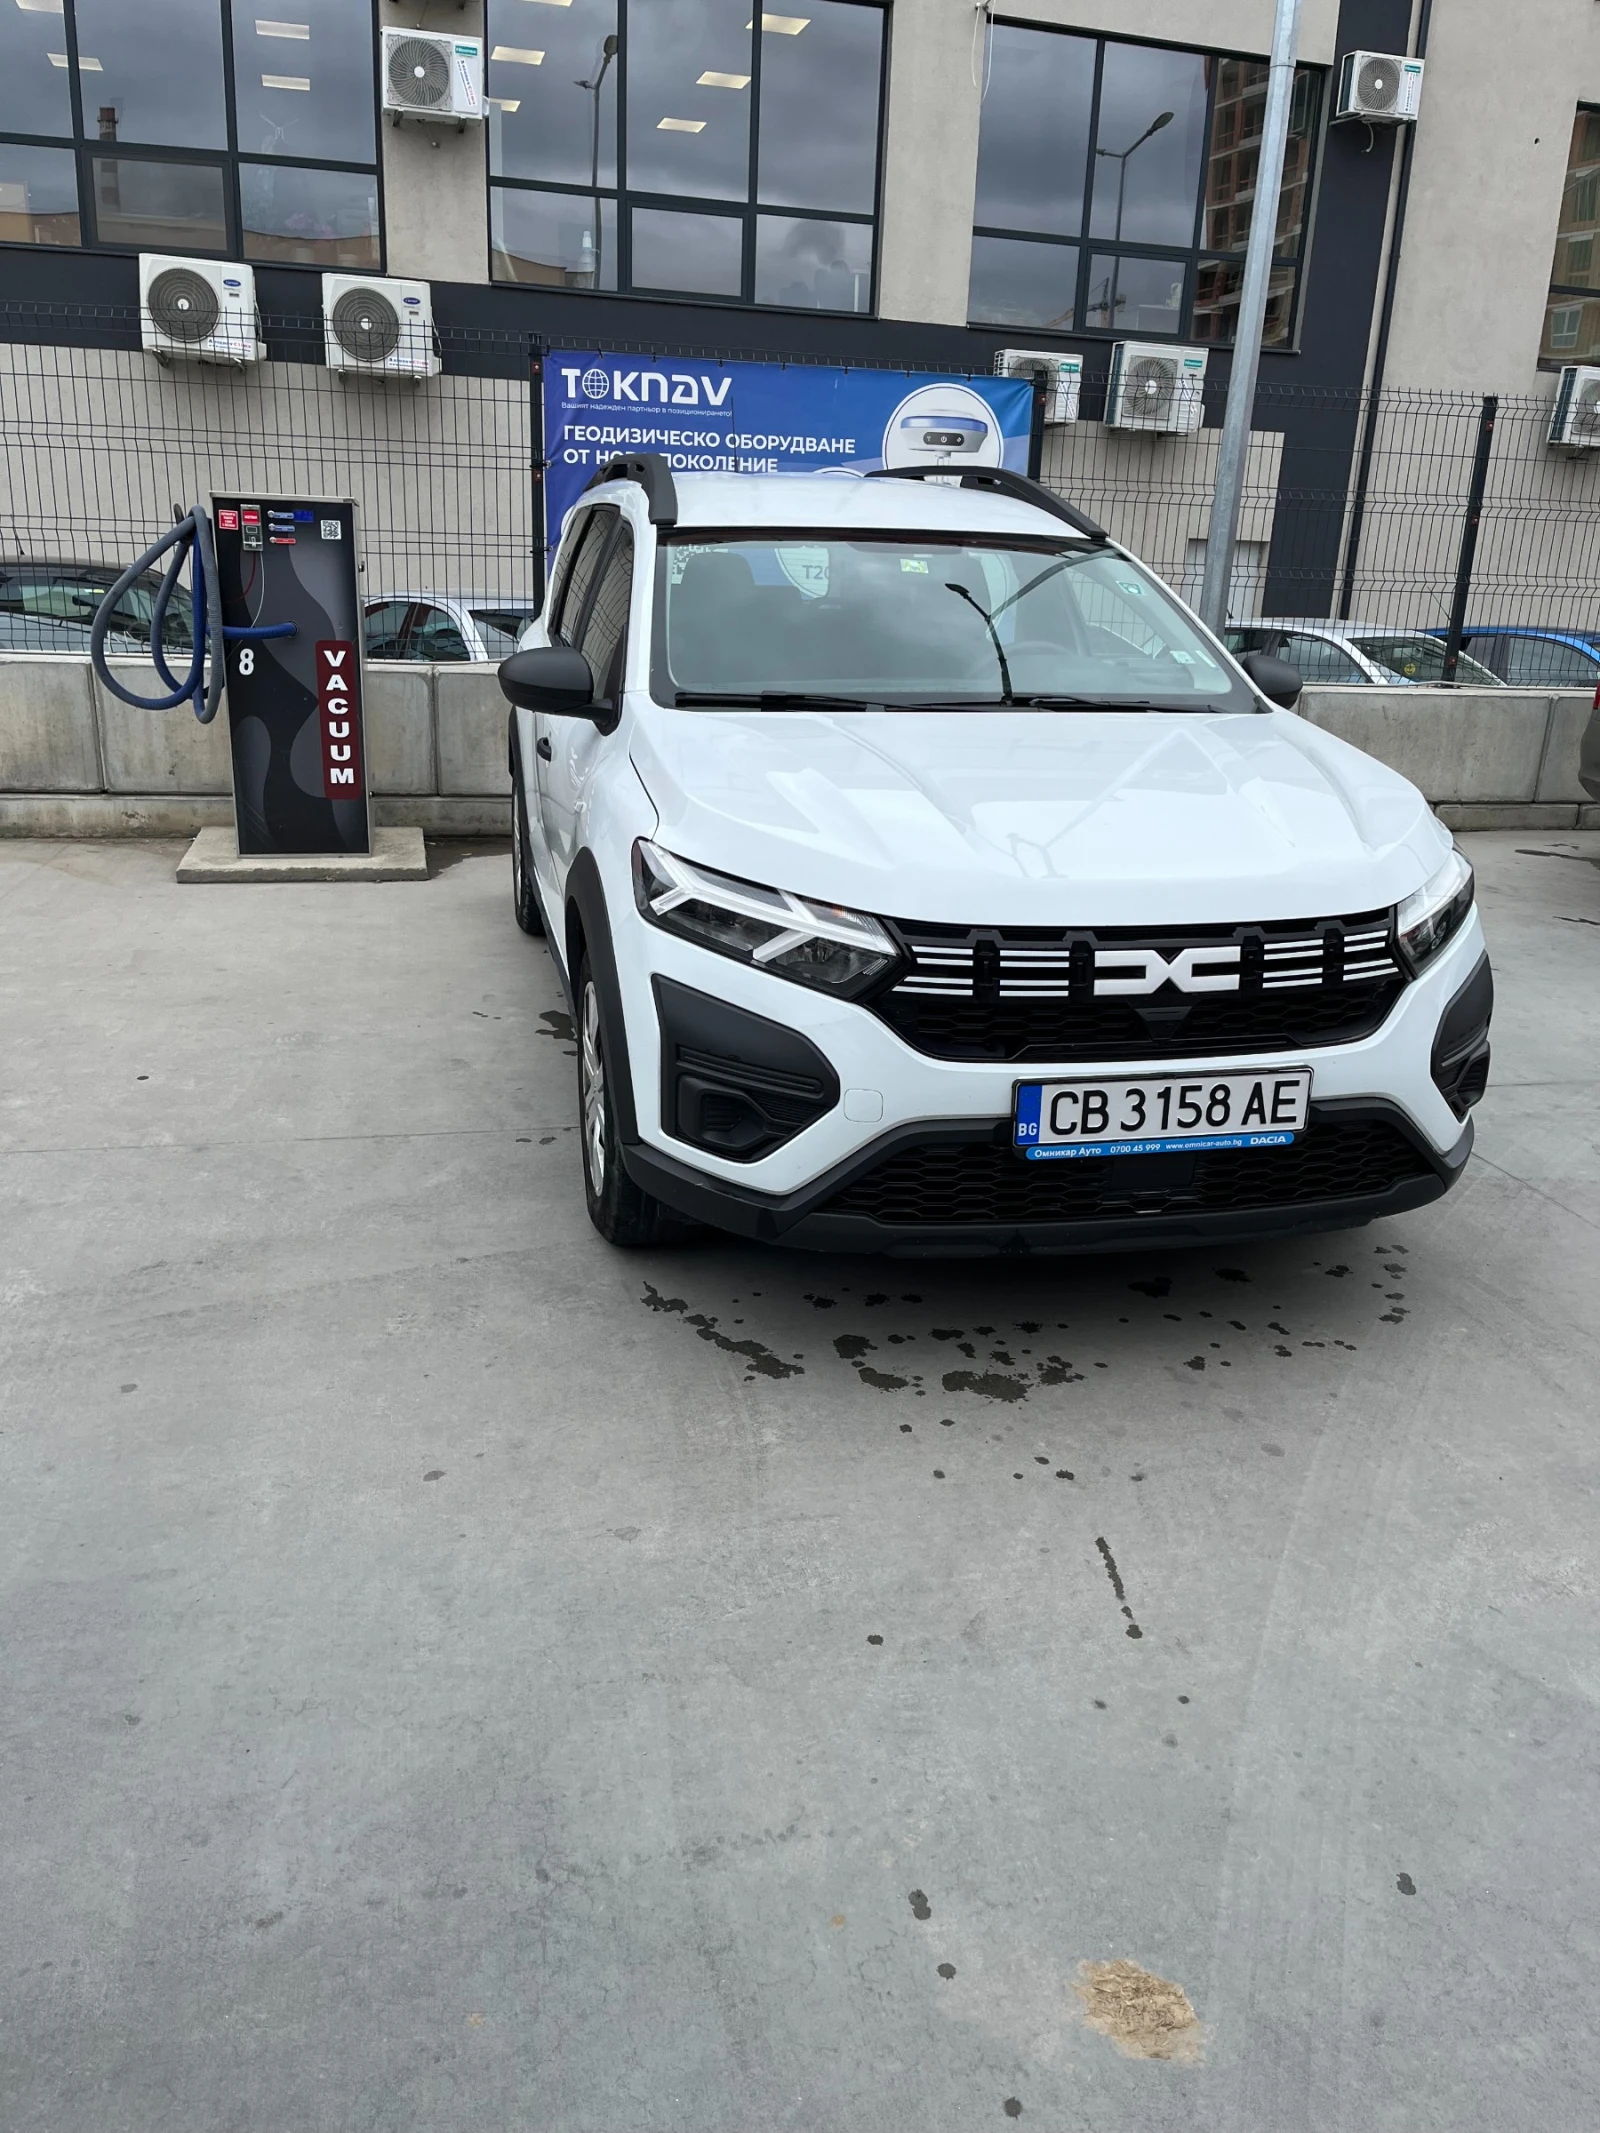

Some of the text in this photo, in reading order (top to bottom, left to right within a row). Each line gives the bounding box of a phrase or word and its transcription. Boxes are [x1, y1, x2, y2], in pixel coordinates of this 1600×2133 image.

[561, 402, 589, 410] Вашият
[590, 403, 626, 412] надежден
[627, 405, 660, 414] партньор
[668, 408, 733, 417] позиционирането!
[564, 425, 856, 454] ГЕОДИЗИЧЕСКО ОБОРУДВАНЕ
[563, 448, 590, 464] ОТ
[238, 648, 254, 676] 8
[323, 650, 355, 784] VACUUM
[1018, 1121, 1038, 1137] BG
[1120, 1083, 1231, 1132] 3158
[1034, 1135, 1286, 1158] Омникар Ауто 0700 45 999 www.omnicar-auto.bg DACIA
